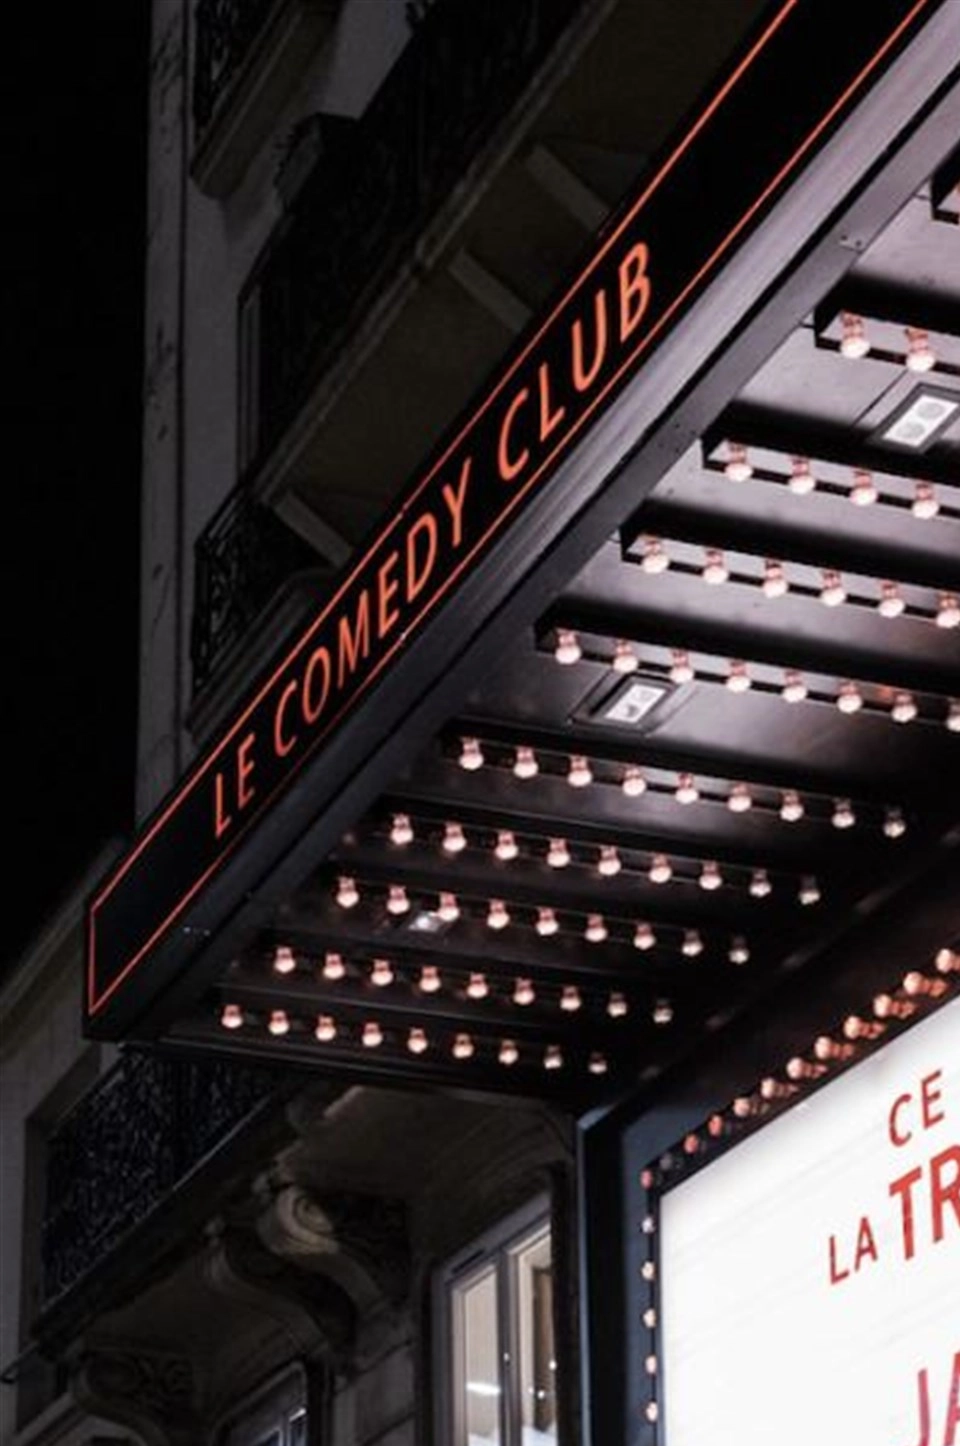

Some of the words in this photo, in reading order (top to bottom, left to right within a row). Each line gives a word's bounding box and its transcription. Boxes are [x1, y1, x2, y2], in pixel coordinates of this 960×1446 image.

[213, 735, 256, 839] LE
[273, 459, 472, 757] COMEDY
[496, 240, 652, 481] CLUB
[888, 1070, 945, 1148] CE
[828, 1215, 878, 1286] LA
